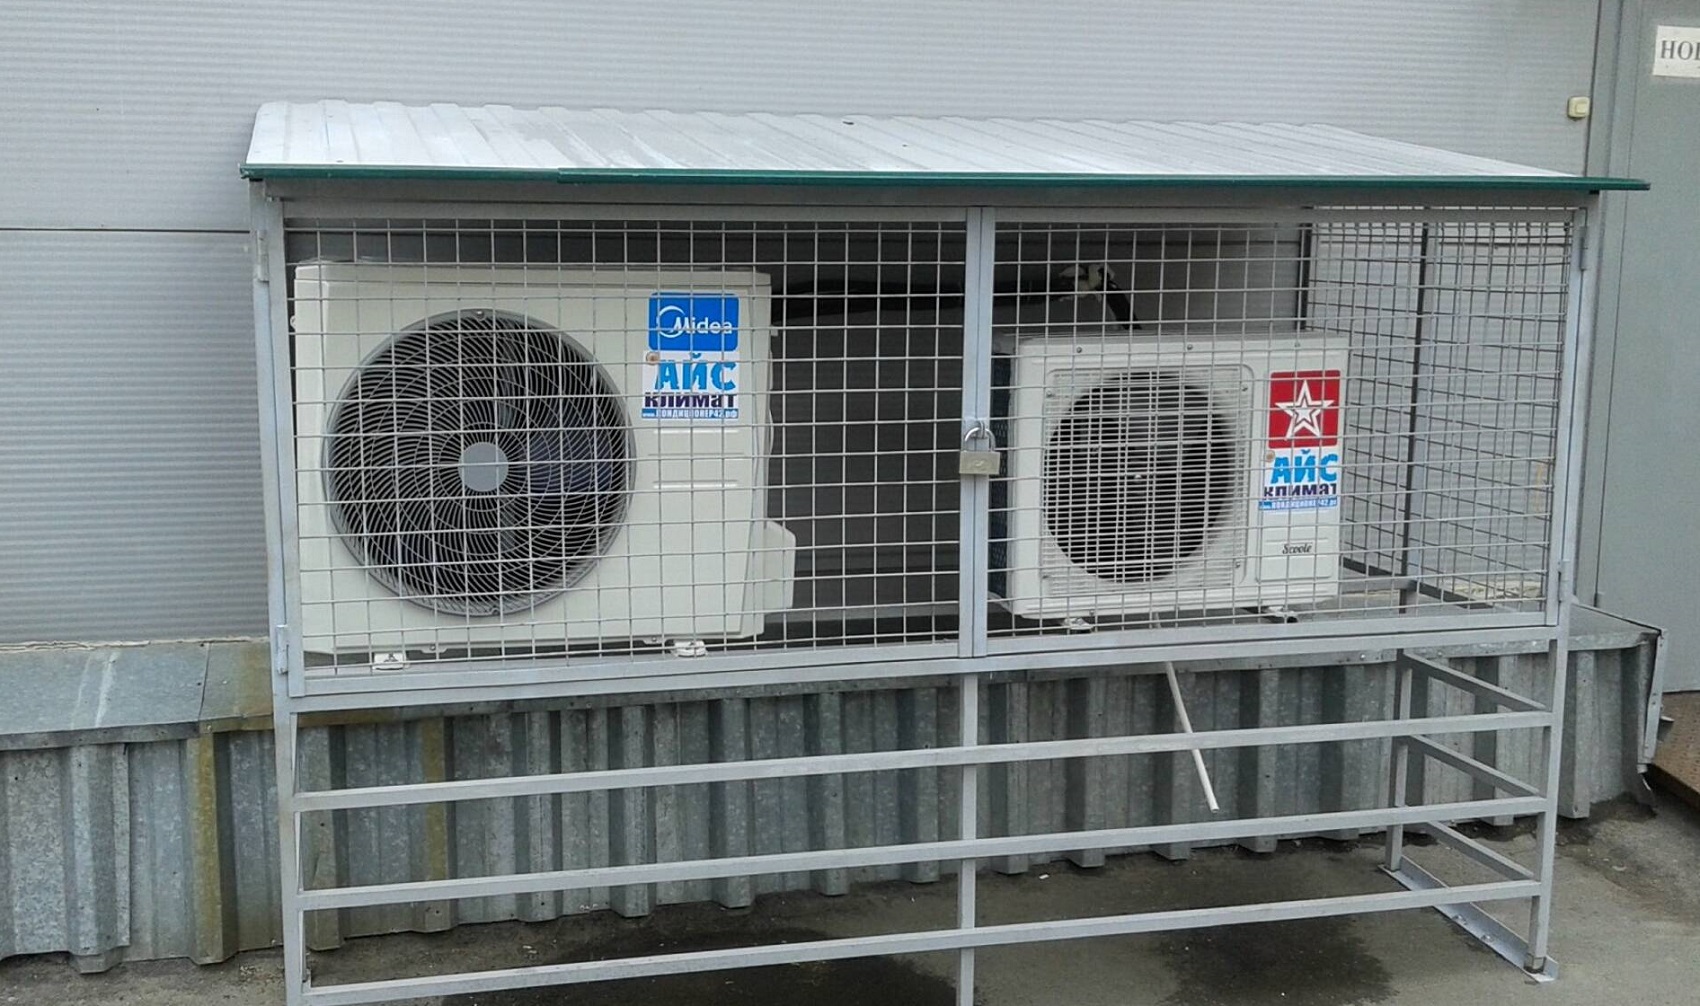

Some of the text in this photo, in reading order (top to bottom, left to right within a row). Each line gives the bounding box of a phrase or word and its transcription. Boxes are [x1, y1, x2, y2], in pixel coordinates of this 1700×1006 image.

[662, 312, 733, 336] Midea
[655, 353, 737, 391] АЙС
[1270, 449, 1338, 484] АЙС
